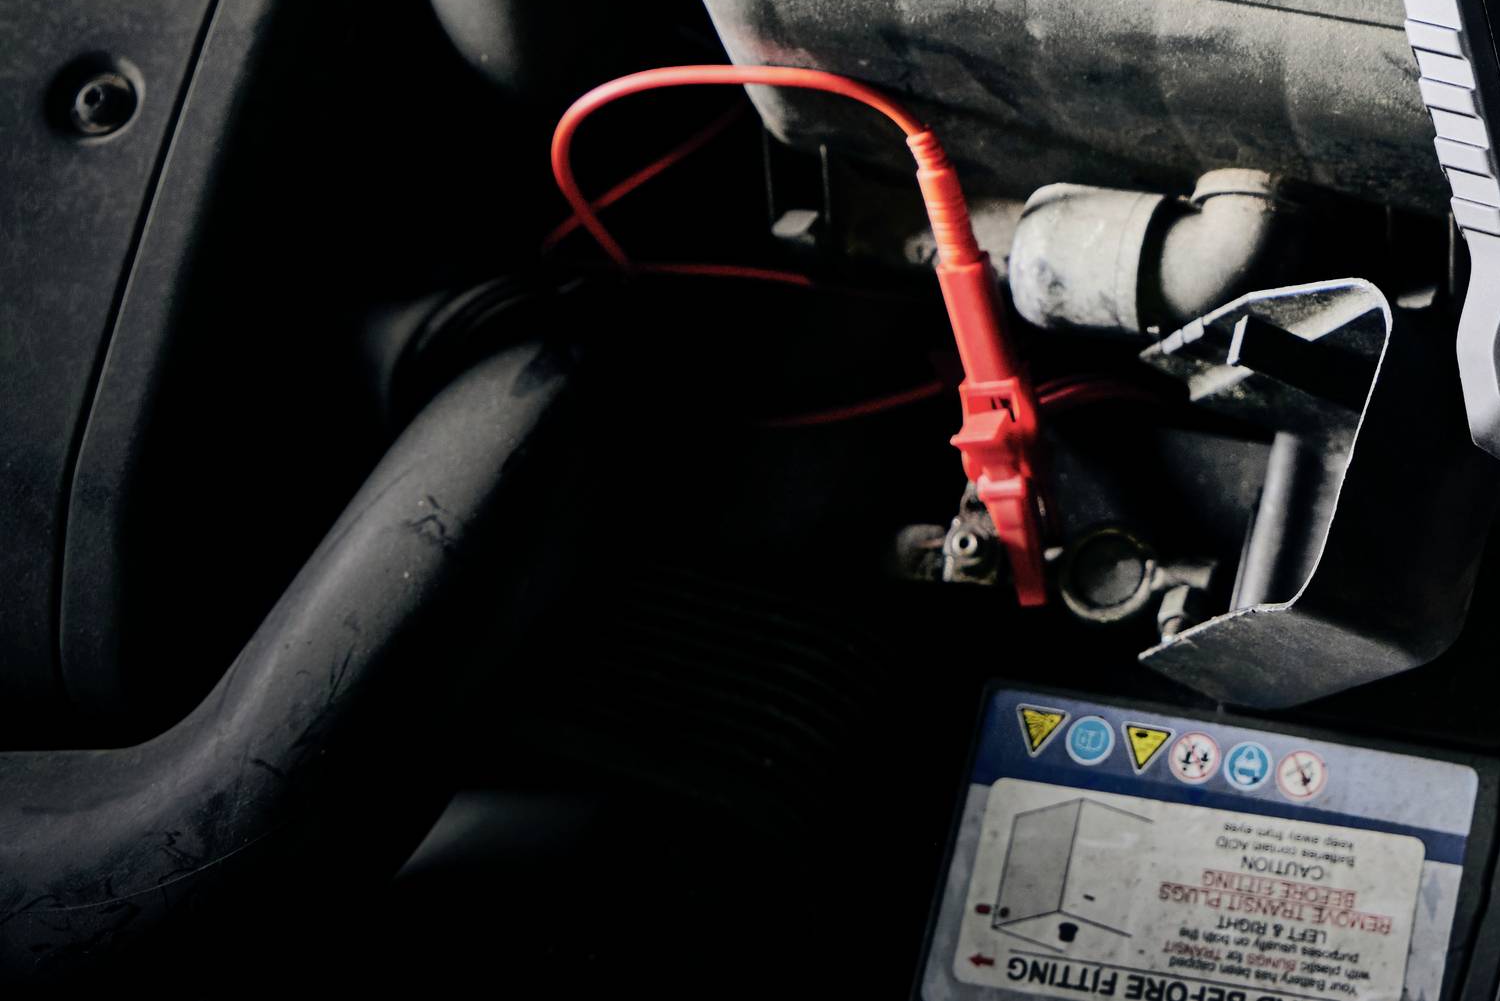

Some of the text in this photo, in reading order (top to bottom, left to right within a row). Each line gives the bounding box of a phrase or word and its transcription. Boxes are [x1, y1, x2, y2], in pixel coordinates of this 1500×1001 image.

[1215, 836, 1249, 852] ACID
[1240, 855, 1325, 882] CAUTION
[1158, 882, 1392, 935] REMOVE TRANSIT PLUGS
[1201, 870, 1356, 909] BEFORE FITTING
[1179, 927, 1359, 963] purposes usually on both the
[1215, 915, 1327, 945] LEFT & RIGHT
[1007, 957, 1118, 996] FITTING
[1163, 940, 1370, 982] with plastic BUNGS for TRANSIT
[1168, 955, 1358, 996] Your Battery has been capped
